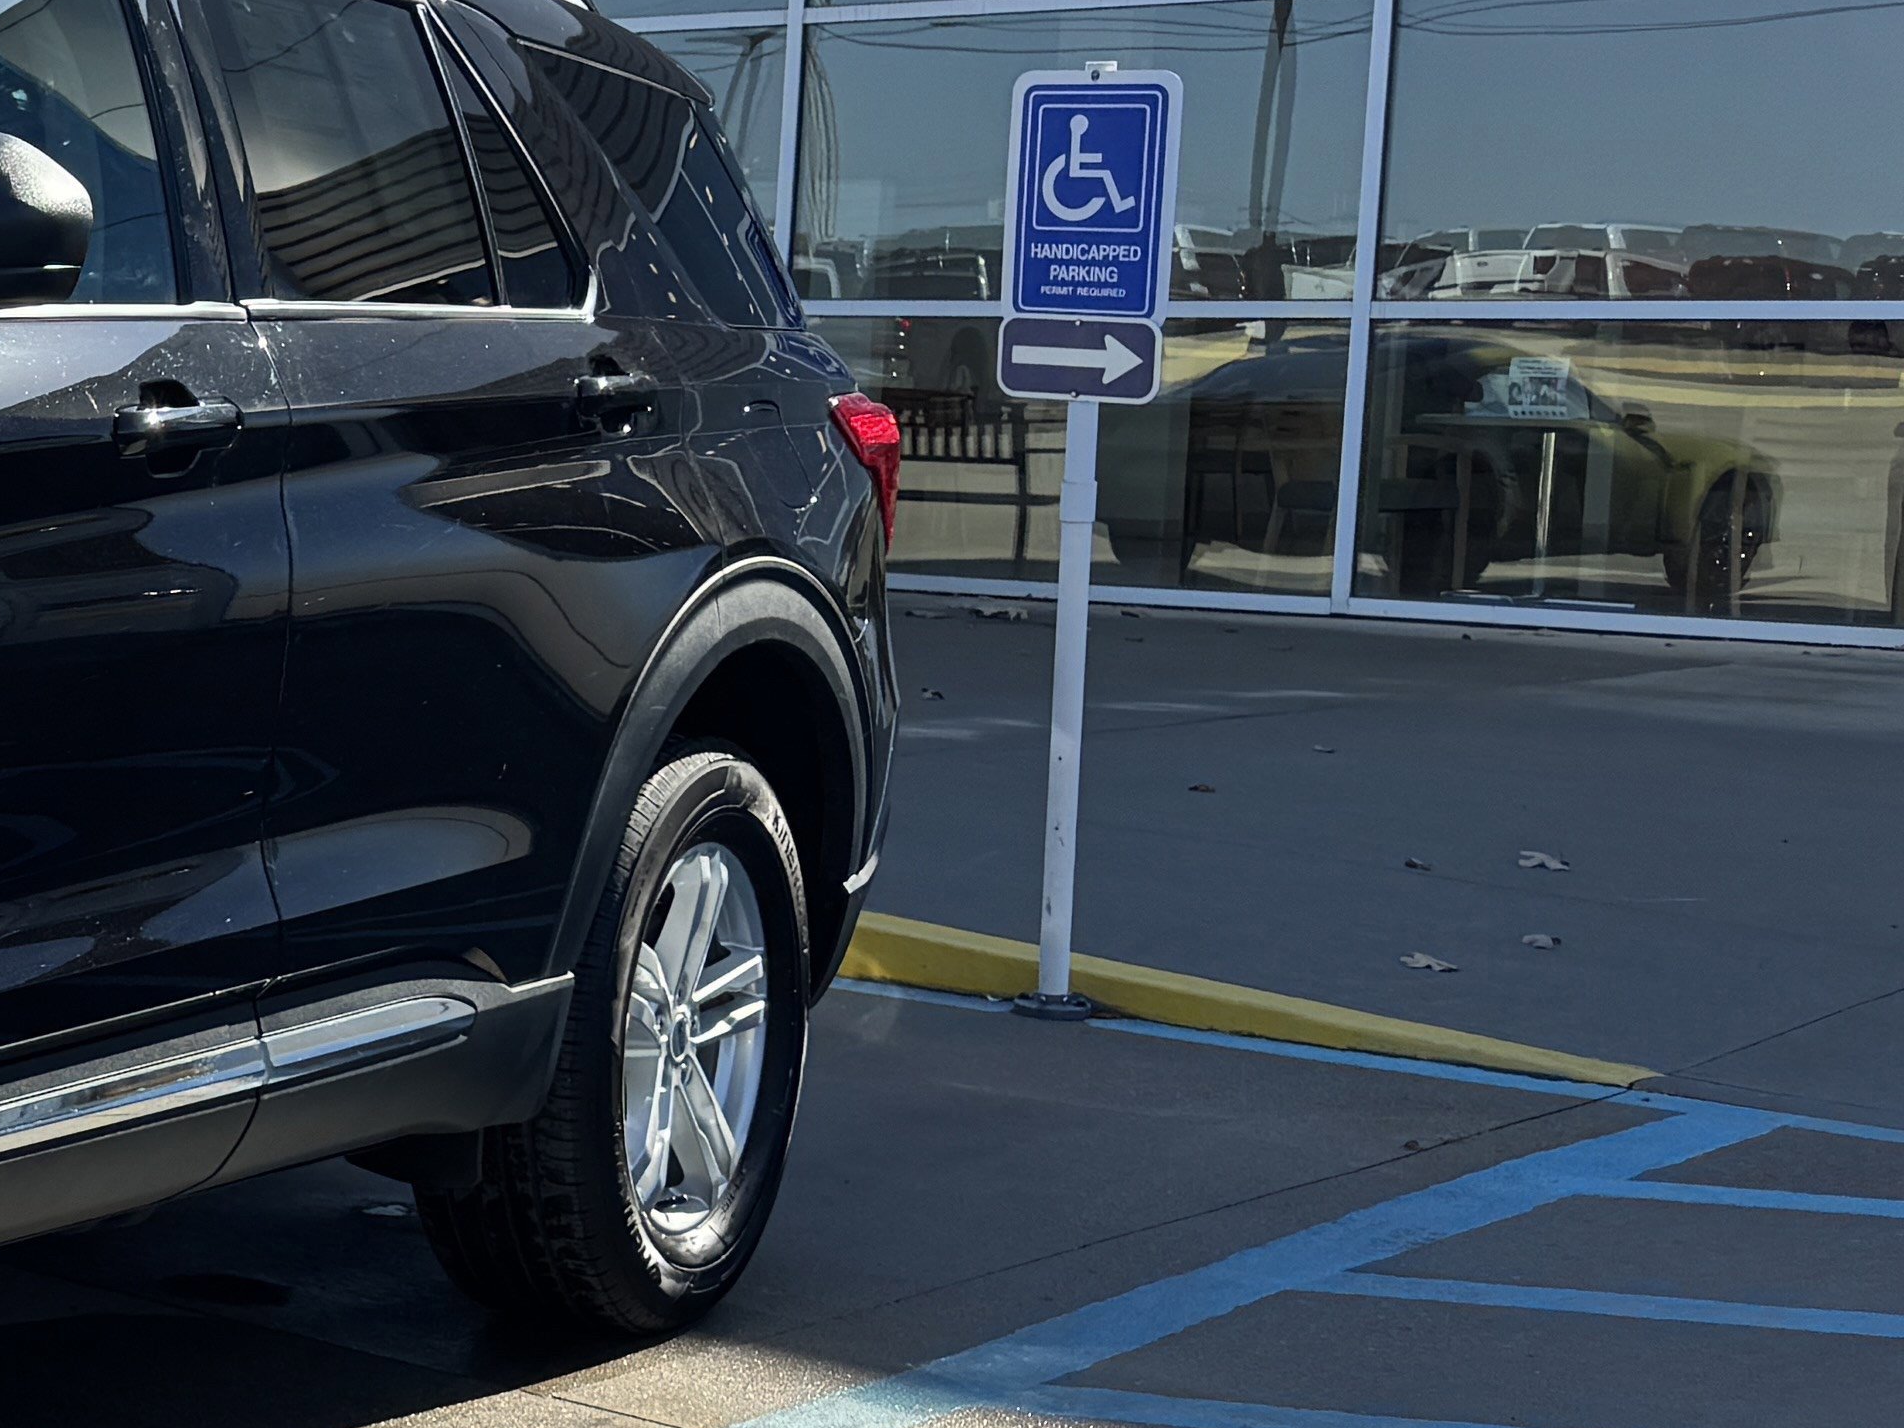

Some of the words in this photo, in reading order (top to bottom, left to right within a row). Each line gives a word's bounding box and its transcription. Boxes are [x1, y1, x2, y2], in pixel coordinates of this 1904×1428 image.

[1030, 242, 1142, 262] HANDICAPPED
[1049, 265, 1119, 283] PARKING
[1076, 286, 1127, 298] REQUIRED
